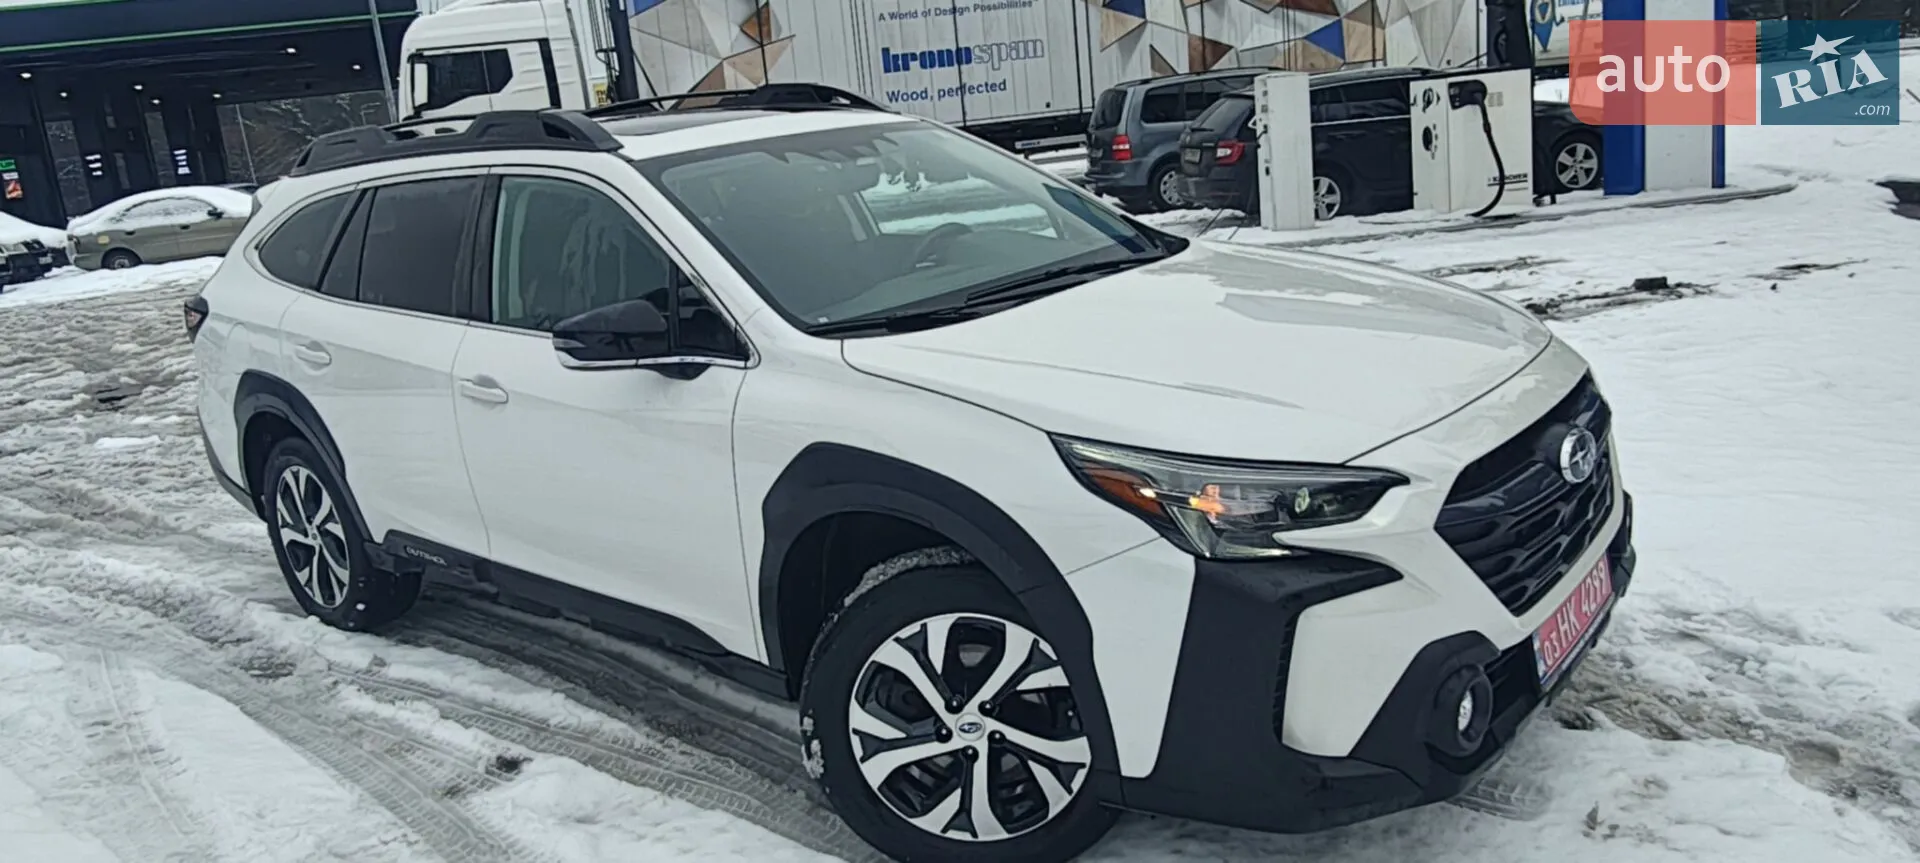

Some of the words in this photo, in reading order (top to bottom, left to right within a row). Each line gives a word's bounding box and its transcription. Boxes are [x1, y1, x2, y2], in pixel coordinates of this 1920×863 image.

[878, 12, 886, 22] A
[888, 10, 919, 21] World
[921, 8, 932, 18] of
[881, 39, 1045, 74] kronospan
[886, 87, 934, 104] Wood,
[937, 79, 1007, 102] perfected
[1543, 631, 1561, 667] 03
[1580, 560, 1607, 617] 4299
